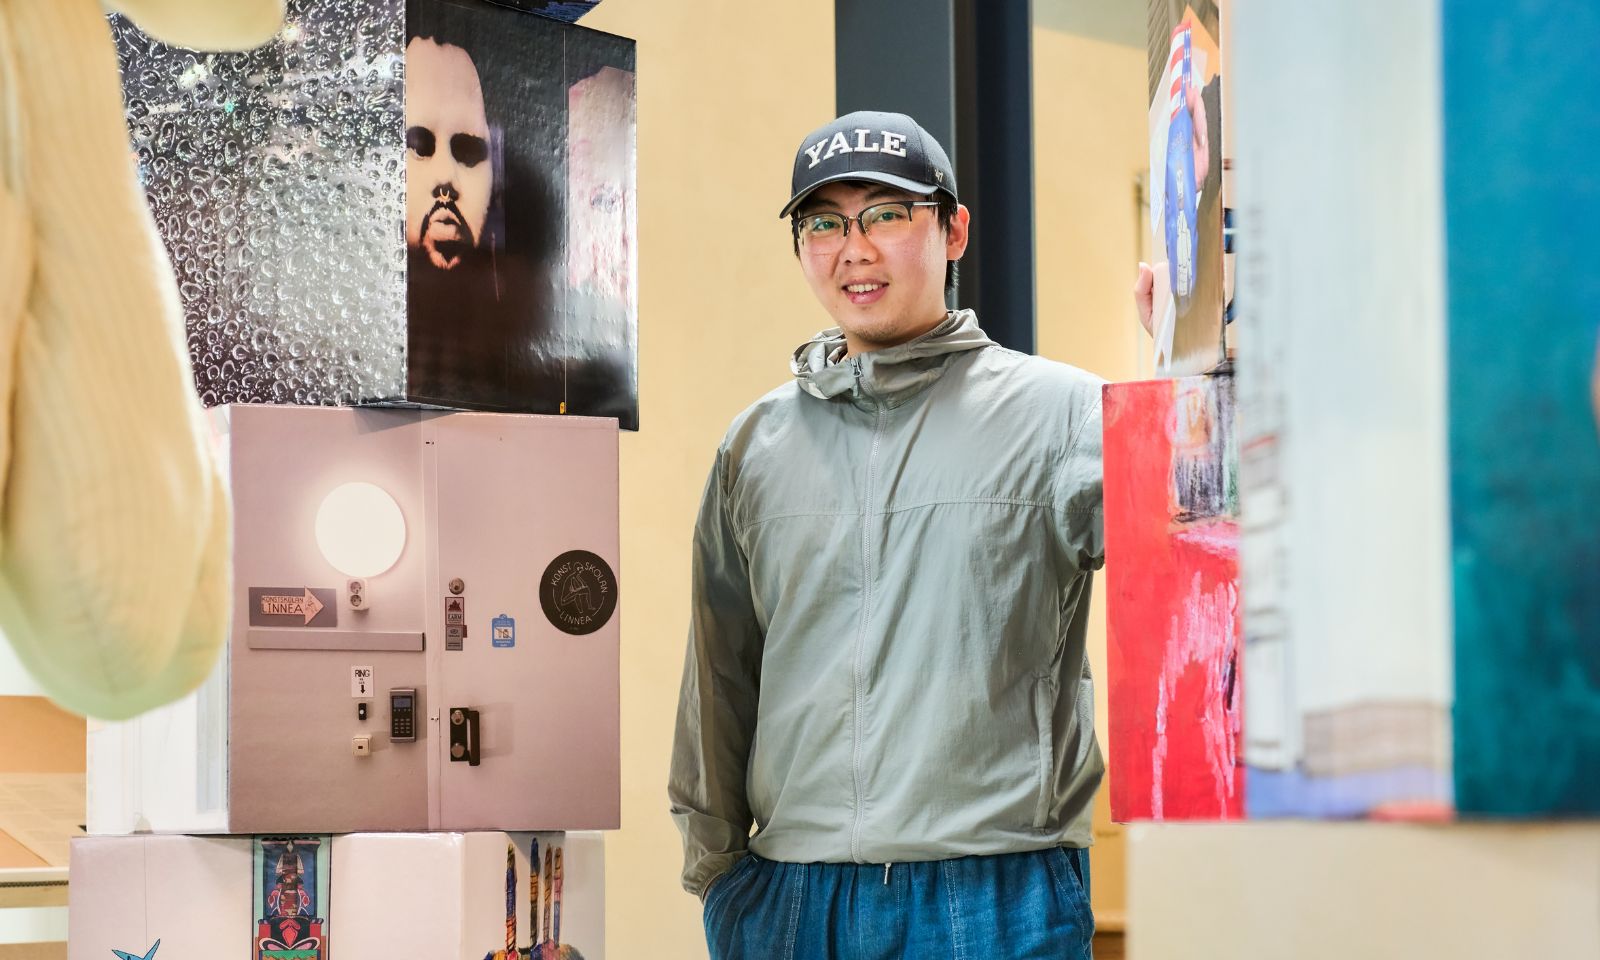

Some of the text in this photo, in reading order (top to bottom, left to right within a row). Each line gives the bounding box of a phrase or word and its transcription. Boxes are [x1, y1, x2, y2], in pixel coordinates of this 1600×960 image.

[804, 129, 907, 170] YALE
[551, 562, 608, 593] KONST SKOLAN
[262, 603, 304, 614] LINNEA
[560, 611, 592, 625] LINNEA
[355, 669, 371, 678] RING
